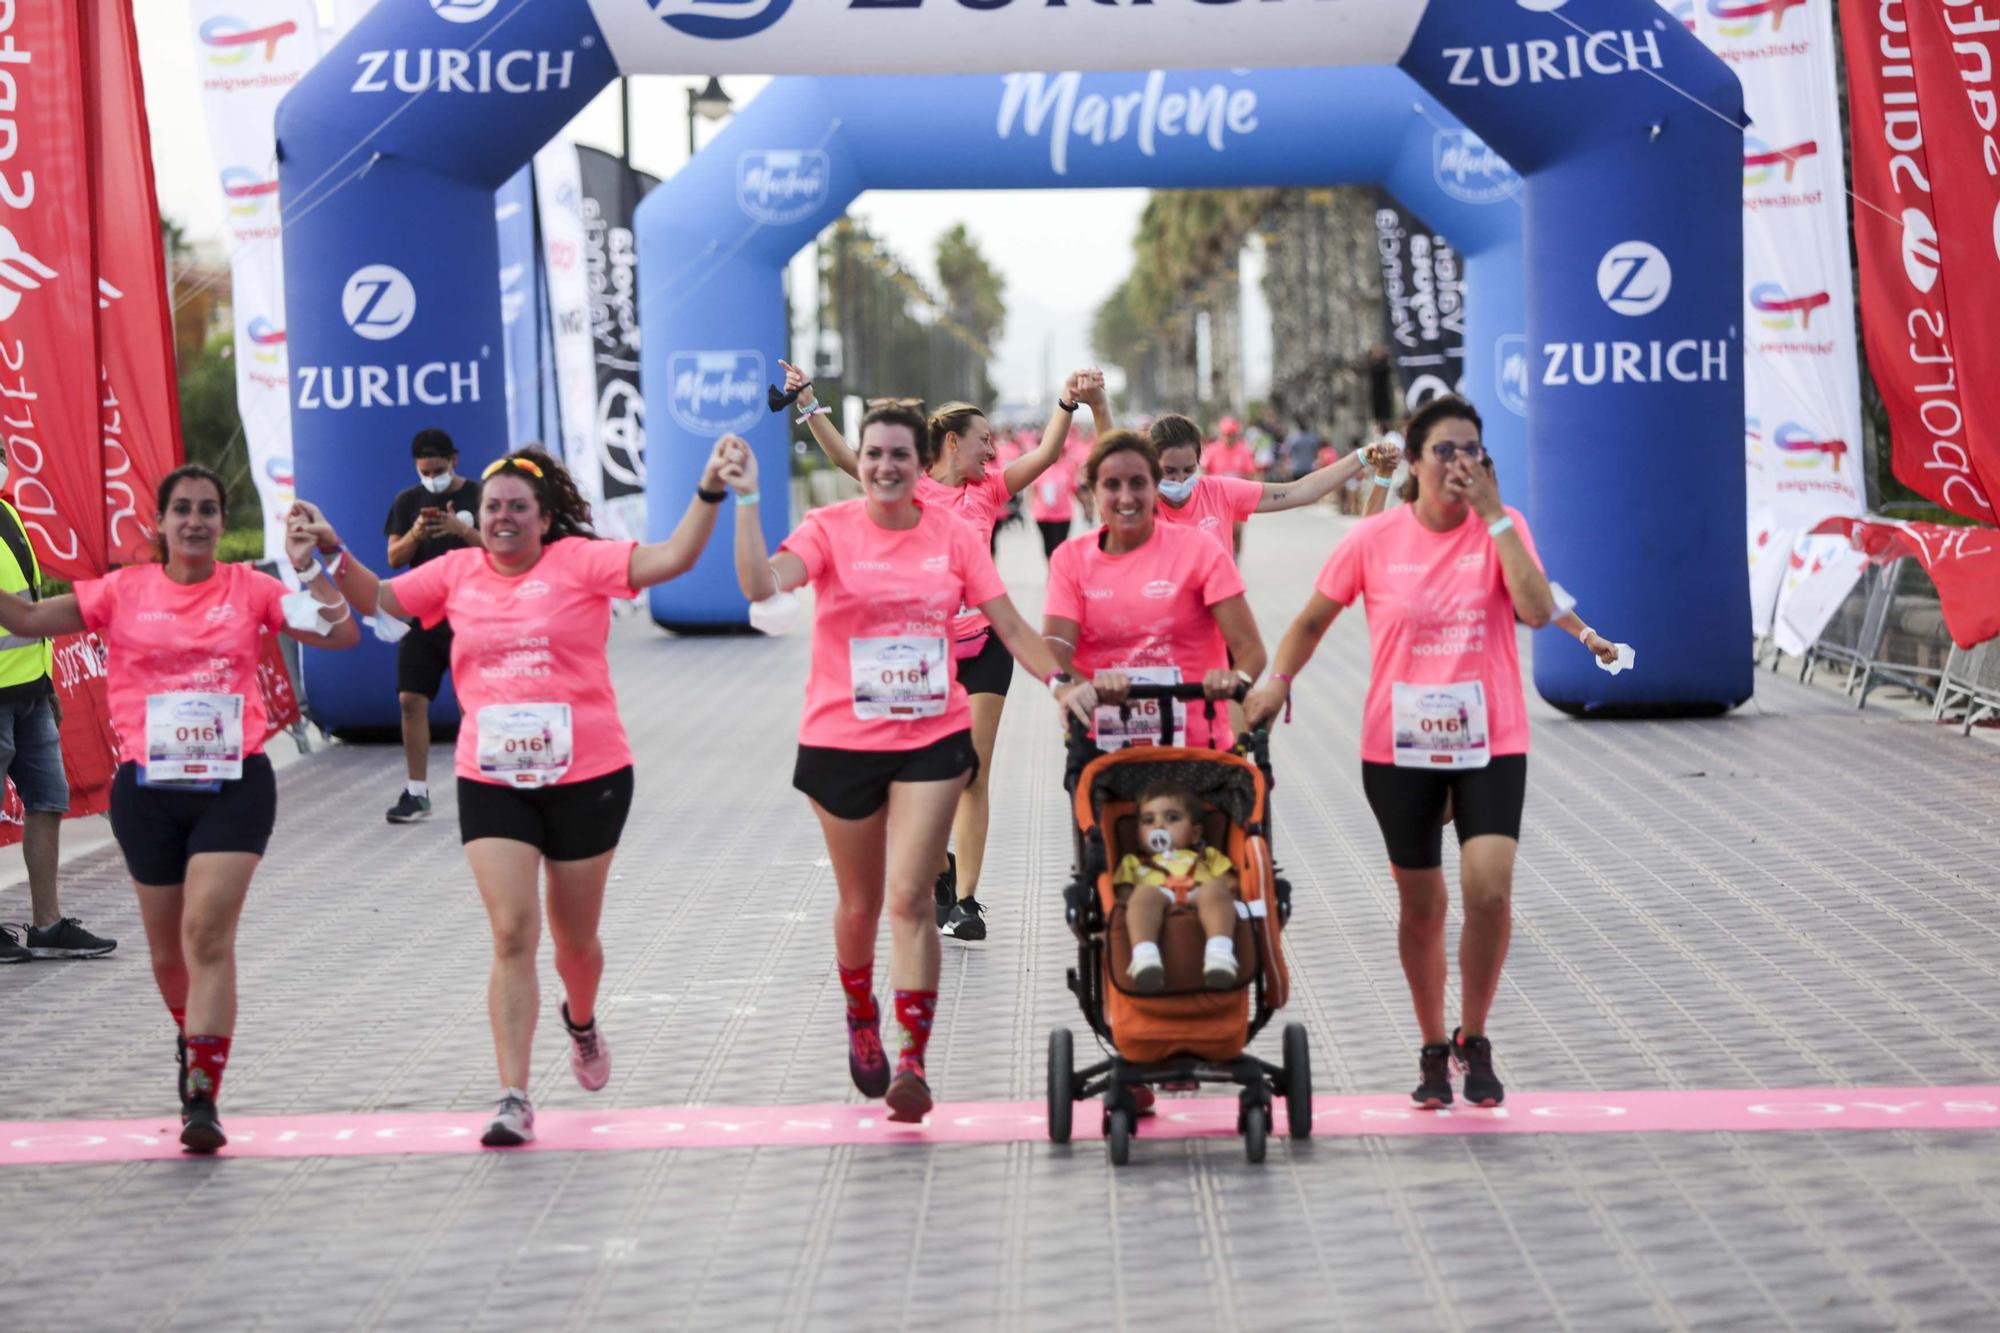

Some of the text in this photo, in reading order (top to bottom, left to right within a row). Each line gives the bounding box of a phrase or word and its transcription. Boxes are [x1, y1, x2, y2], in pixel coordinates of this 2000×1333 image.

[1442, 30, 1663, 87] ZURICH
[351, 49, 575, 93] ZURICH
[1542, 340, 1728, 385] ZURICH
[298, 362, 479, 409] ZURICH
[881, 670, 920, 684] 016
[1130, 700, 1157, 716] 16
[1420, 718, 1459, 733] 016
[176, 726, 215, 742] 016
[505, 737, 543, 753] 016
